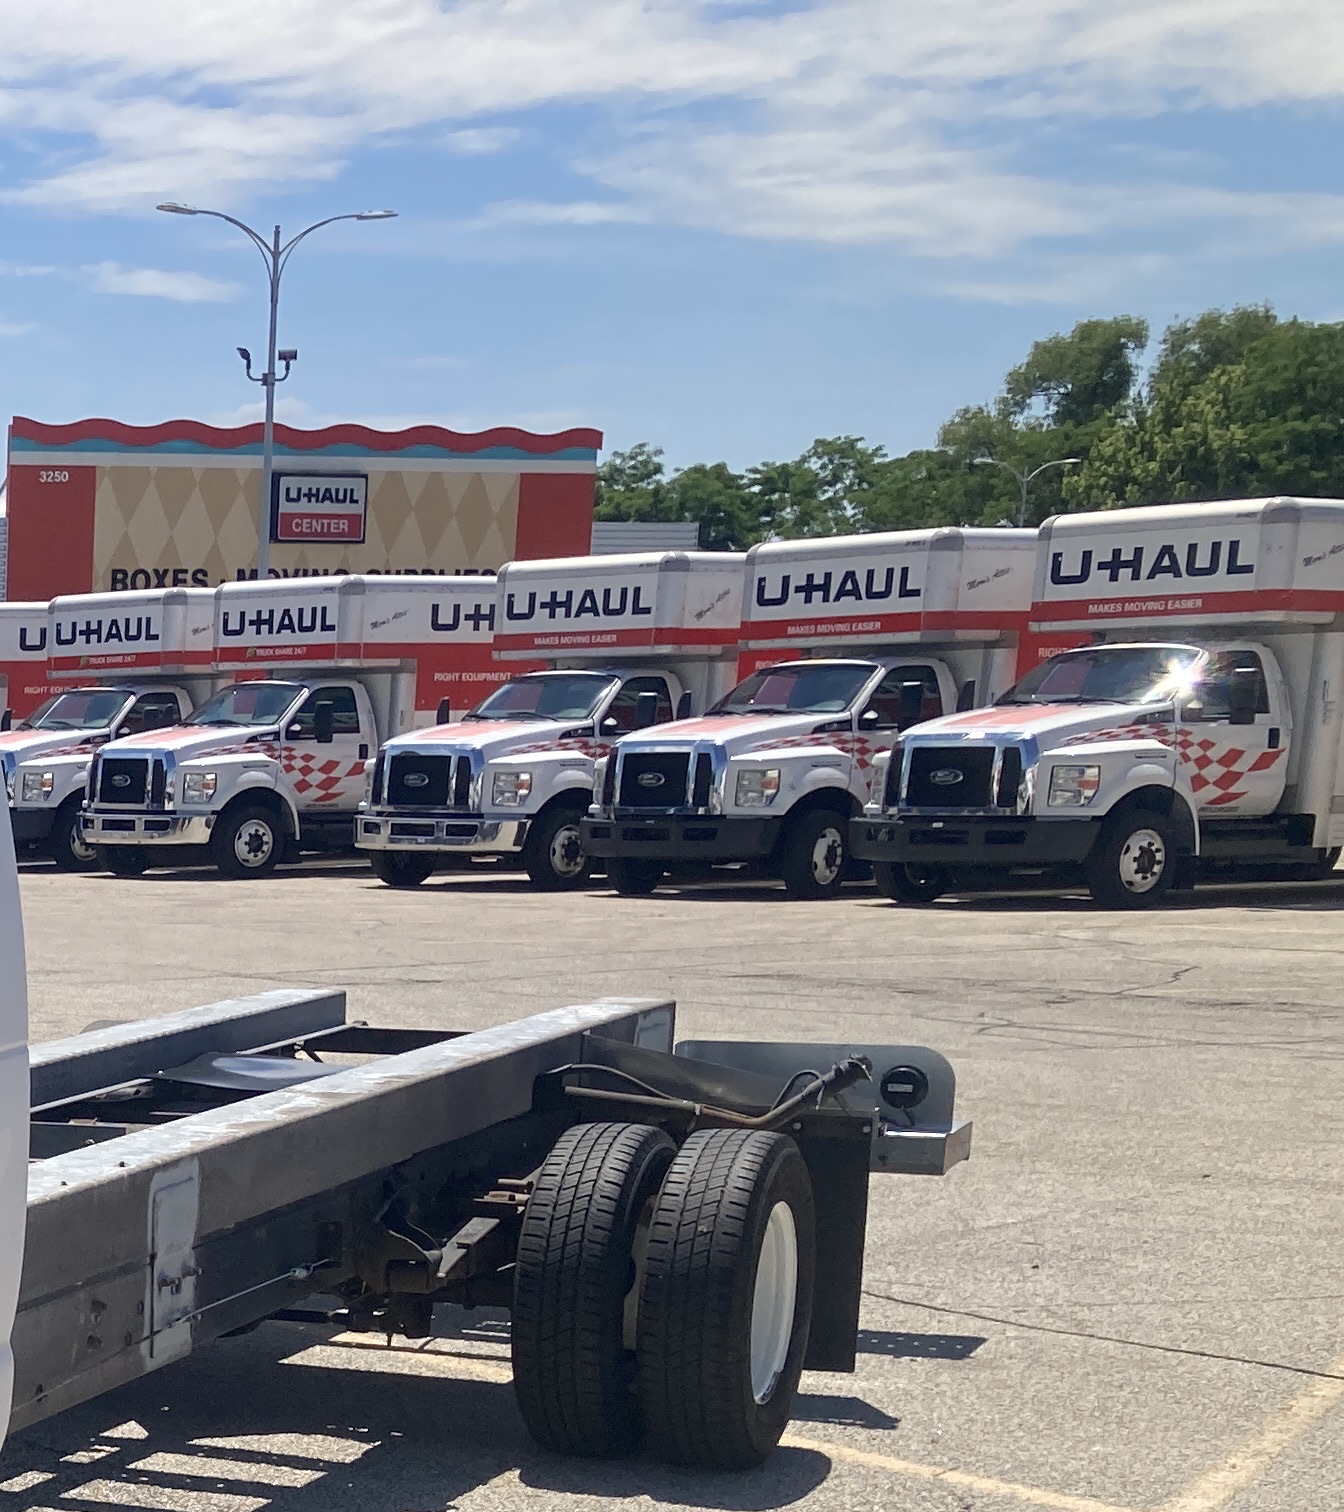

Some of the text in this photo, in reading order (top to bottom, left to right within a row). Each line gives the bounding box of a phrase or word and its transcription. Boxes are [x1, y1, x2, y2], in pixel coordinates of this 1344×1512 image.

[39, 470, 69, 483] 3250
[285, 486, 359, 504] U-HAUL
[291, 518, 349, 533] CENTER
[1050, 539, 1254, 585] U-HAUL
[110, 568, 209, 592] BOXES
[756, 566, 921, 607] U-HAUL
[506, 586, 653, 621] U-HAUL
[1088, 598, 1203, 614] MAKES MOVING EASIER
[55, 616, 160, 645] U-HAUL
[222, 605, 336, 636] U-HAUL
[434, 672, 460, 681] RIGHT
[461, 672, 511, 681] EQUIPMENT
